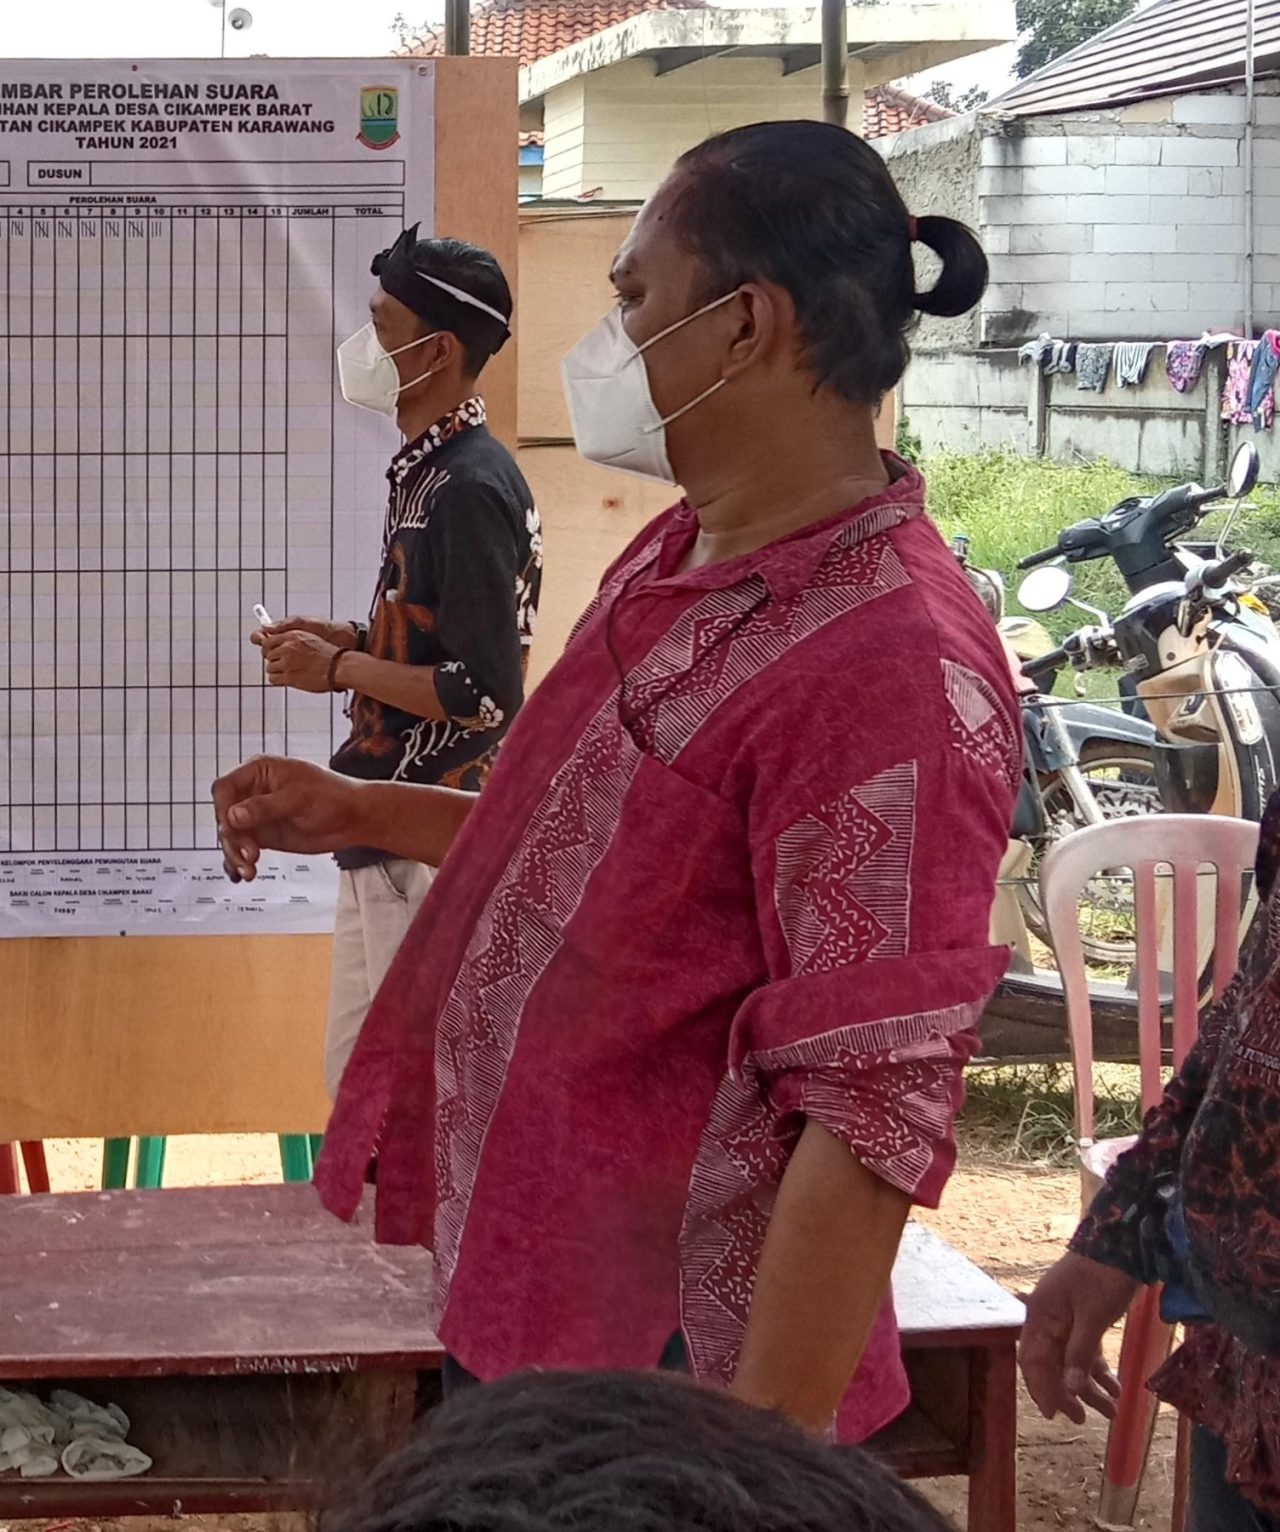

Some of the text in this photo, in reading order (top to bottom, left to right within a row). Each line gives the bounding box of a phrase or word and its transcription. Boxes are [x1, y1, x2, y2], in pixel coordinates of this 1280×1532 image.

[69, 83, 199, 100] PEROLEHAN
[205, 83, 280, 100] SUARA
[43, 102, 110, 116] KEPALA
[114, 102, 160, 116] DESA
[163, 102, 252, 116] CIKAMPEK
[256, 103, 313, 116] BARAT
[37, 119, 126, 133] CIKAMPEK
[130, 119, 233, 133] KABUPATEN
[237, 119, 335, 133] KARAWANG
[75, 136, 178, 149] TAHUN 2021
[37, 169, 82, 179] DUSUN
[69, 196, 157, 204] PEROLEHAN SUARA
[291, 208, 329, 216] JUMLAH
[355, 207, 383, 215] TOTAL
